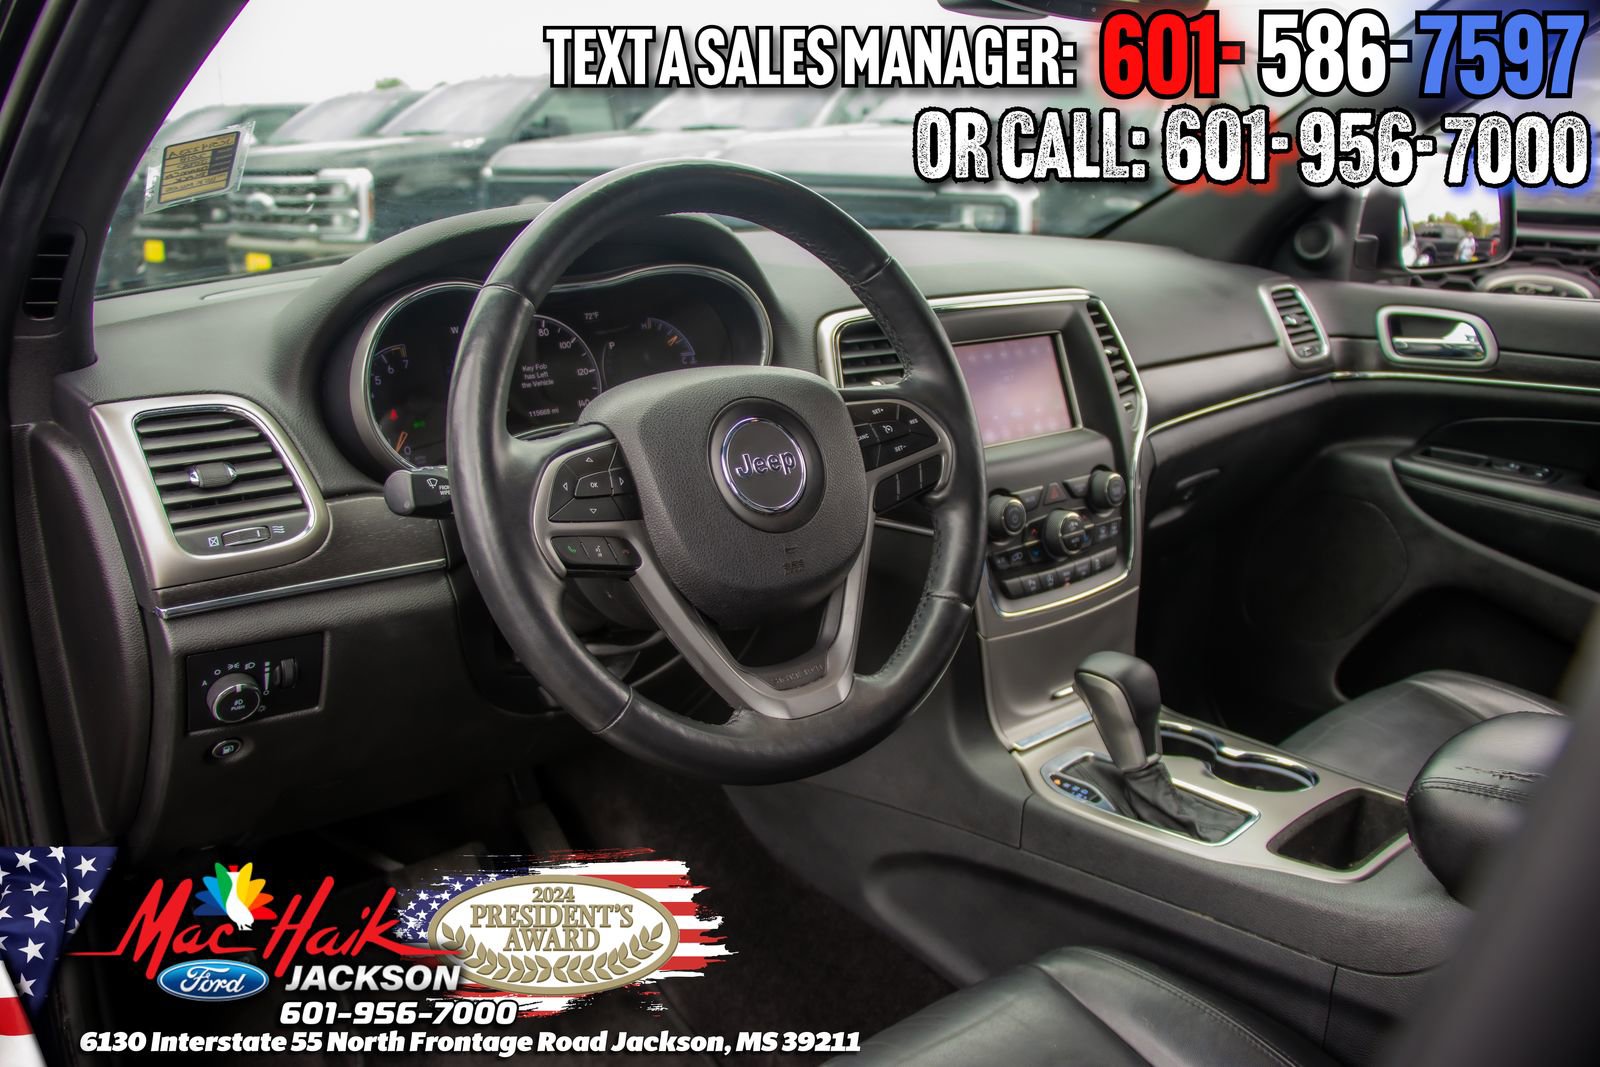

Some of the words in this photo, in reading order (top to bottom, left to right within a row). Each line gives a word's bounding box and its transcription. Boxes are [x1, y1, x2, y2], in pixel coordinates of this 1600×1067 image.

[538, 328, 550, 337] 80
[559, 341, 571, 350] 100
[609, 342, 615, 350] P
[402, 359, 409, 369] 7
[535, 362, 548, 372] Fob
[387, 364, 395, 375] 6
[536, 370, 549, 379] Left
[577, 367, 589, 377] 120
[374, 375, 382, 386] 5
[533, 378, 555, 388] Vehicle
[736, 451, 796, 479] Jeep
[590, 481, 599, 489] OK
